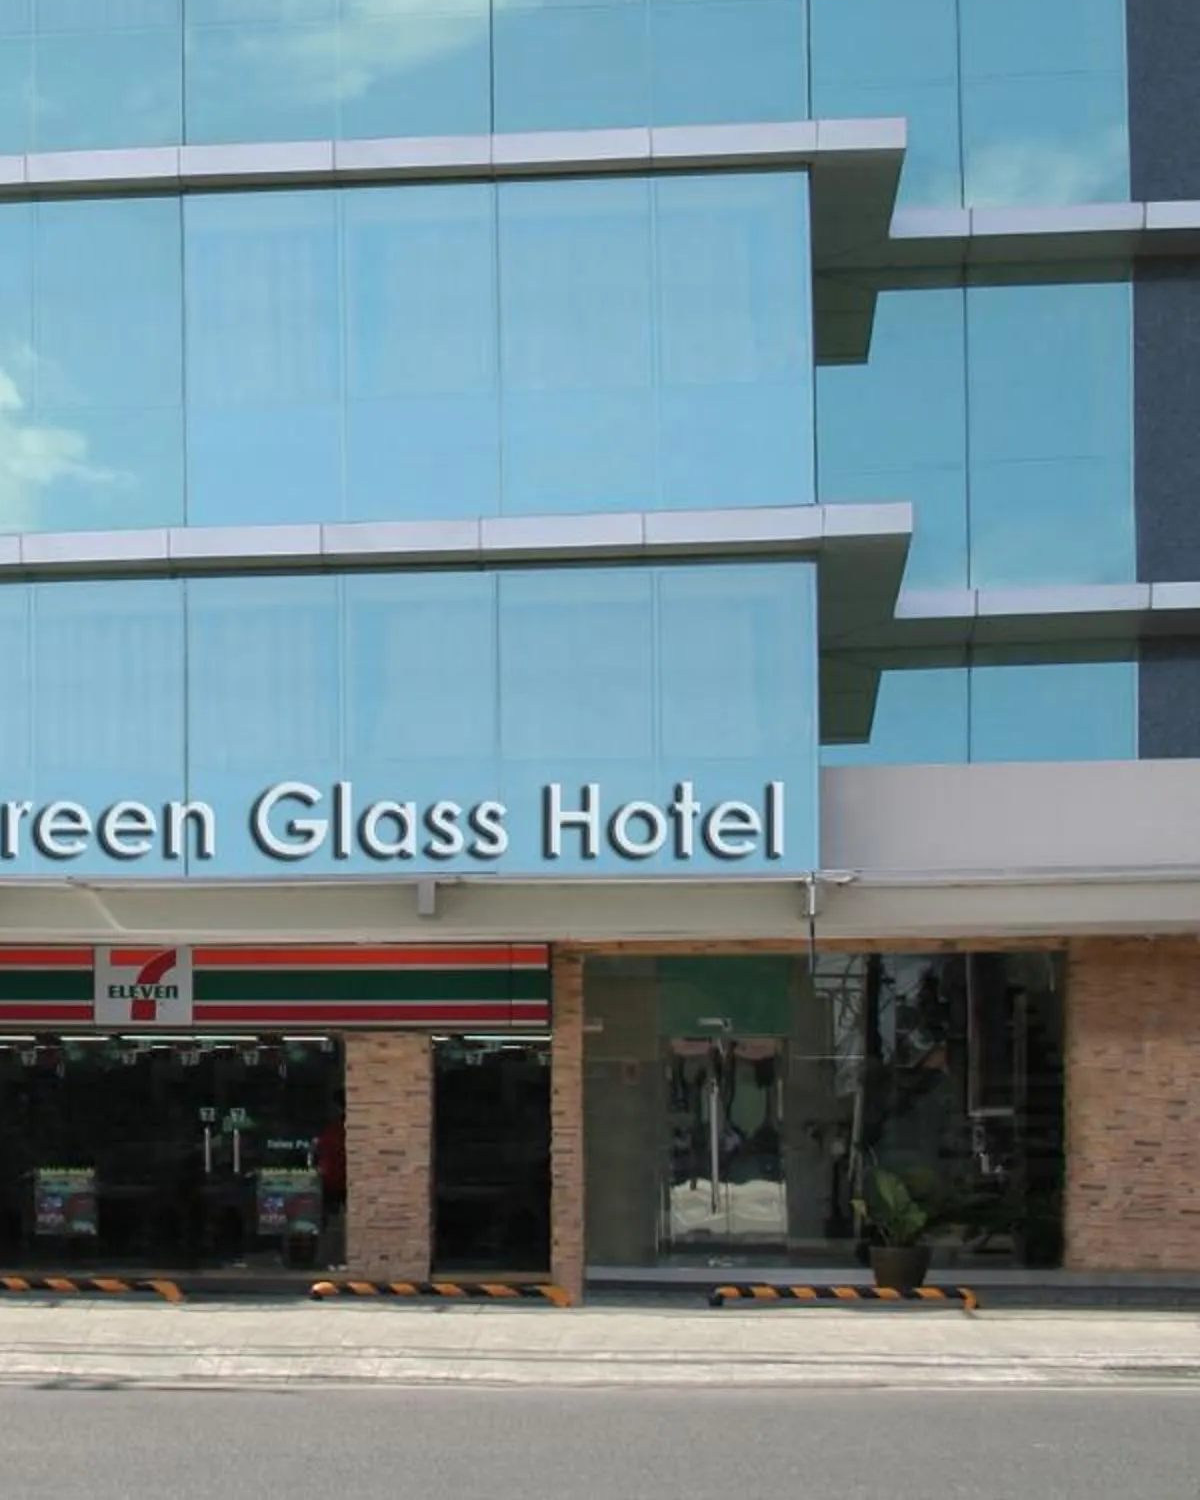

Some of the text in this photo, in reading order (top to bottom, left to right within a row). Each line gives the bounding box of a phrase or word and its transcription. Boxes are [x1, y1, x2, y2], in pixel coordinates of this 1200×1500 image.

[252, 780, 509, 861] Glass
[543, 780, 786, 861] Hotel
[109, 949, 177, 1021] 7
